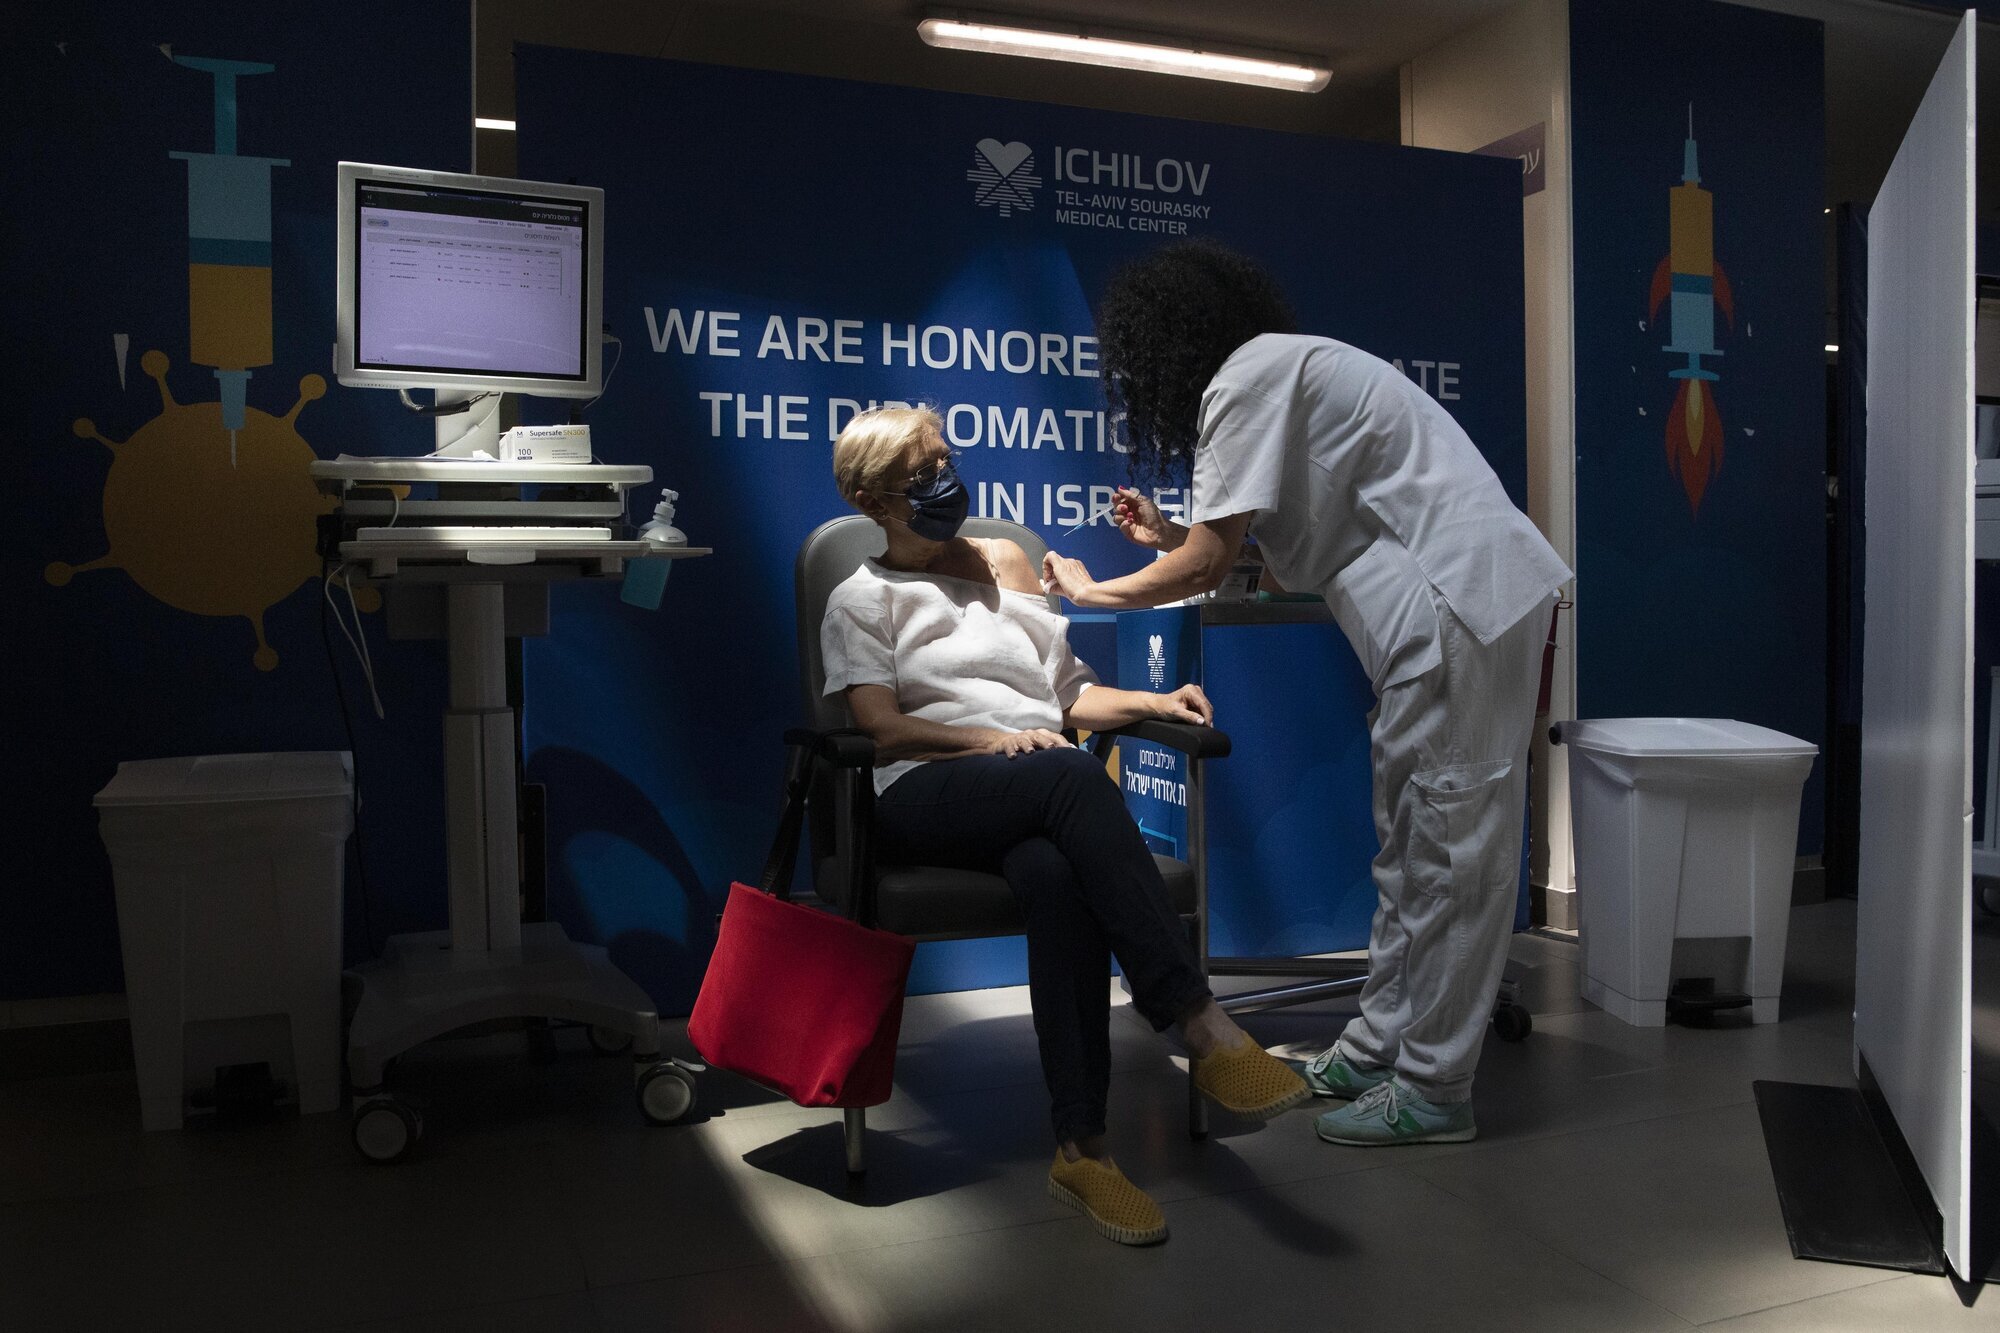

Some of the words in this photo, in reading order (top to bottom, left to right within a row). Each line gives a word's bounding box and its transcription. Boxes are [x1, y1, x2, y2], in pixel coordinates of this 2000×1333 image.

[1055, 146, 1211, 197] ICHILOV
[1056, 190, 1127, 212] TEL-AVIV
[1130, 197, 1211, 220] SOURASKY
[1056, 209, 1125, 231] MEDICAL
[1128, 215, 1188, 236] CENTER
[644, 307, 740, 357] WE
[757, 315, 864, 364] ARE
[882, 322, 1122, 379] HONORE
[699, 391, 810, 441] THE
[979, 482, 1026, 526] IN
[1125, 764, 1150, 796] ישראל
[1152, 777, 1176, 804] אזרחי
